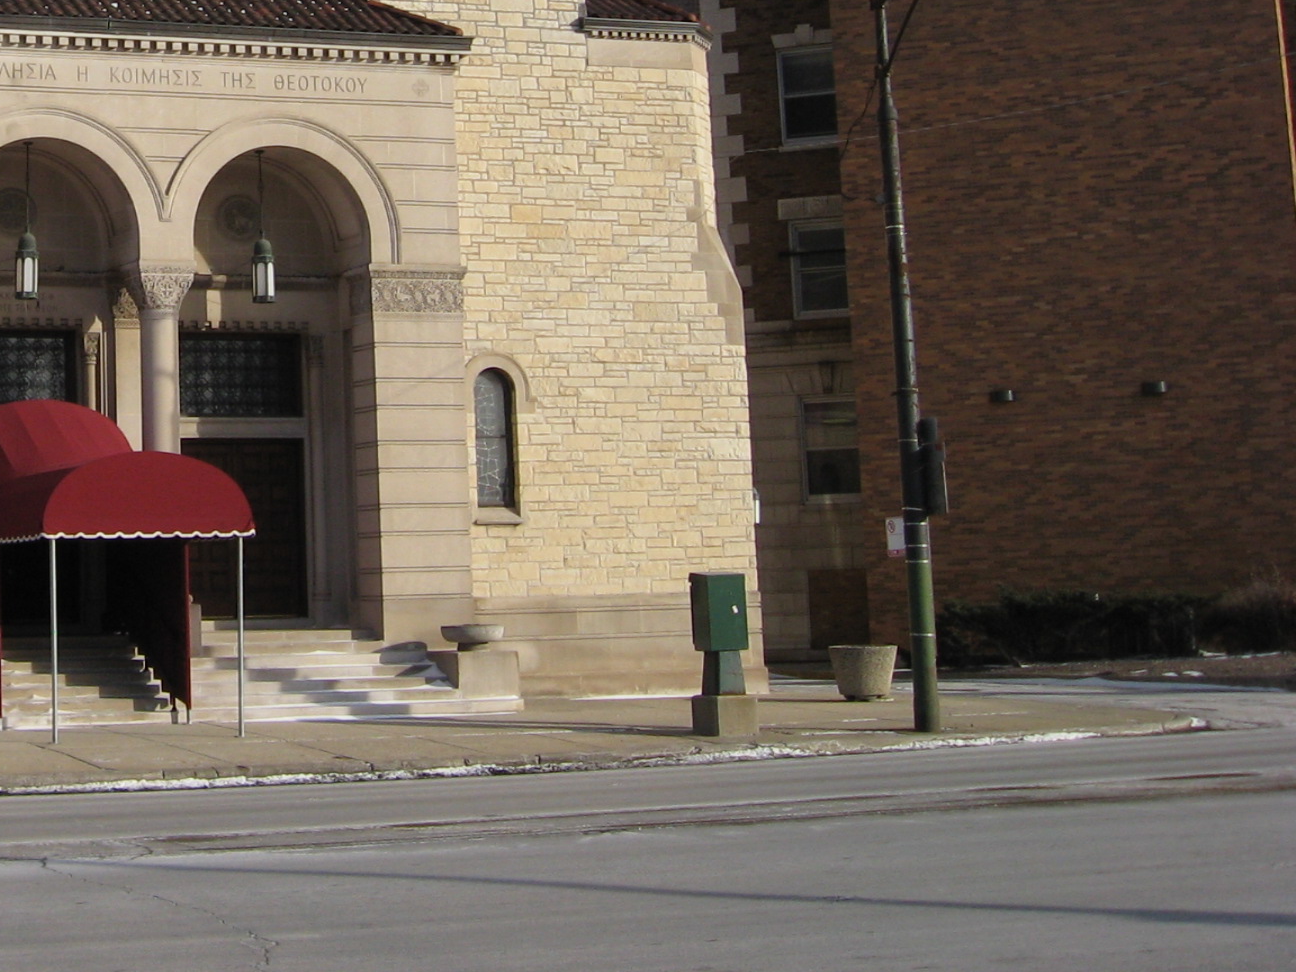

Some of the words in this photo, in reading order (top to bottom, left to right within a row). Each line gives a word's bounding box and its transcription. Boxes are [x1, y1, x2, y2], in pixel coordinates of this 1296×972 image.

[109, 66, 203, 87] ΚΟΙΜΗΣΙΣ
[220, 71, 257, 90] ΤΗΣ
[273, 74, 368, 94] ΘΕΟΤΟΚΟΥ
